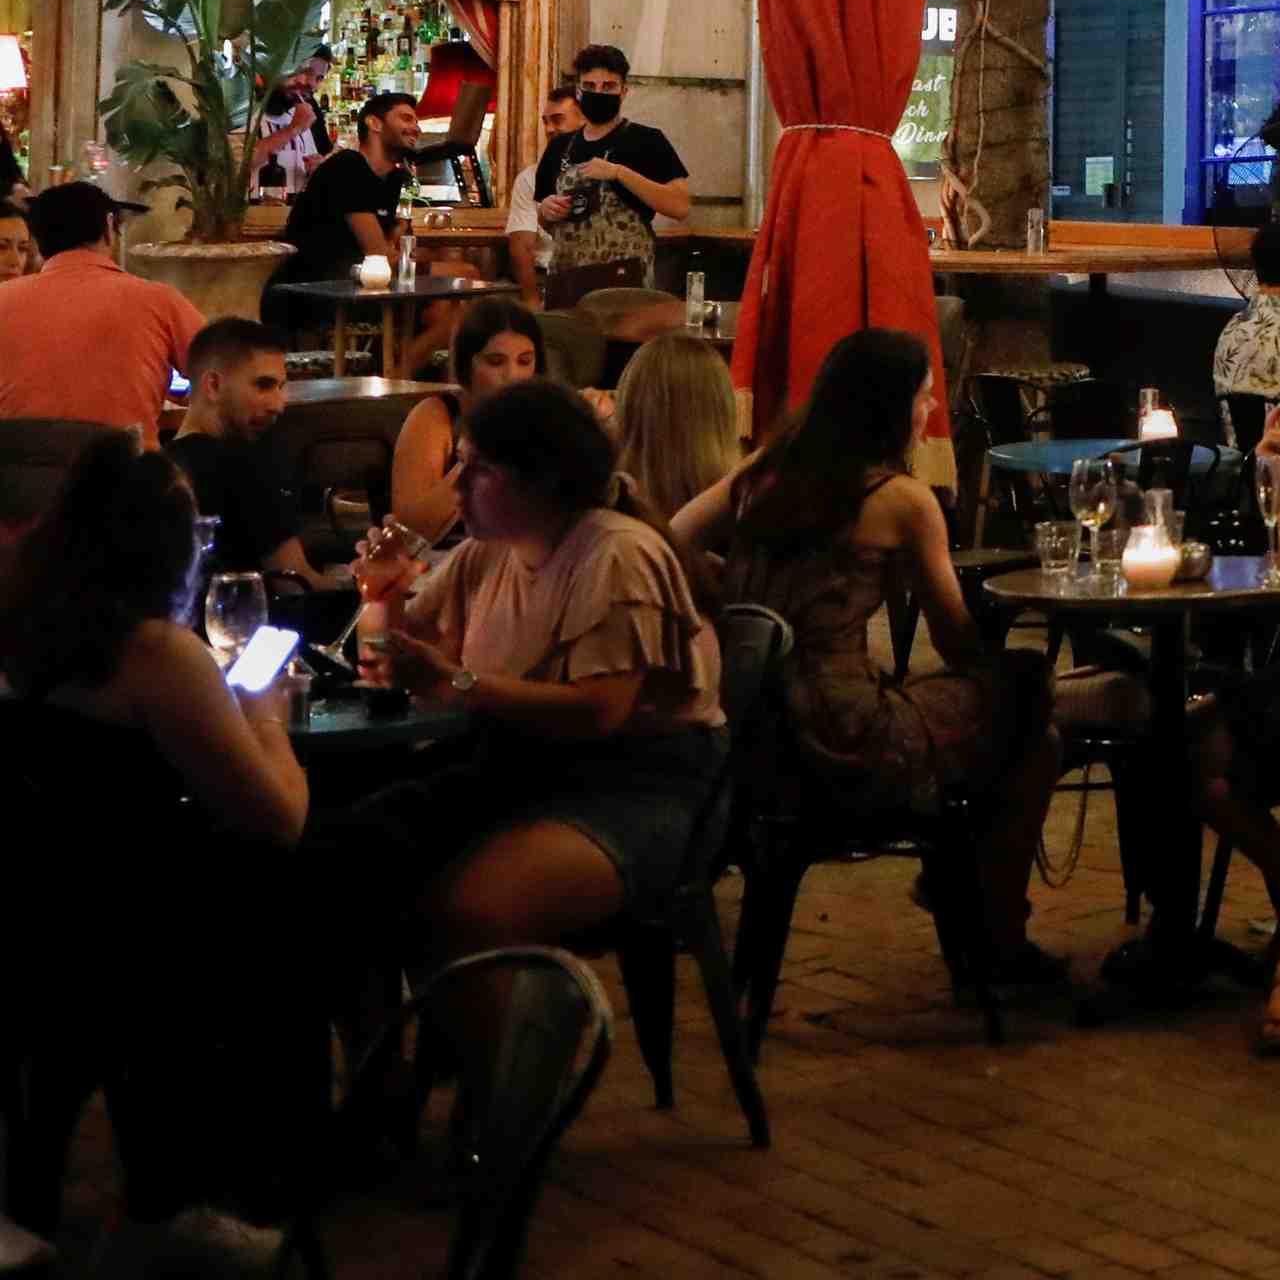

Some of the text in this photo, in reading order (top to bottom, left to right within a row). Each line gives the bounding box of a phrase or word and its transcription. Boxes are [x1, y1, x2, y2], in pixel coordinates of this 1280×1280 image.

[911, 73, 946, 92] ast
[905, 99, 929, 117] ch
[895, 121, 948, 145] Dinn
